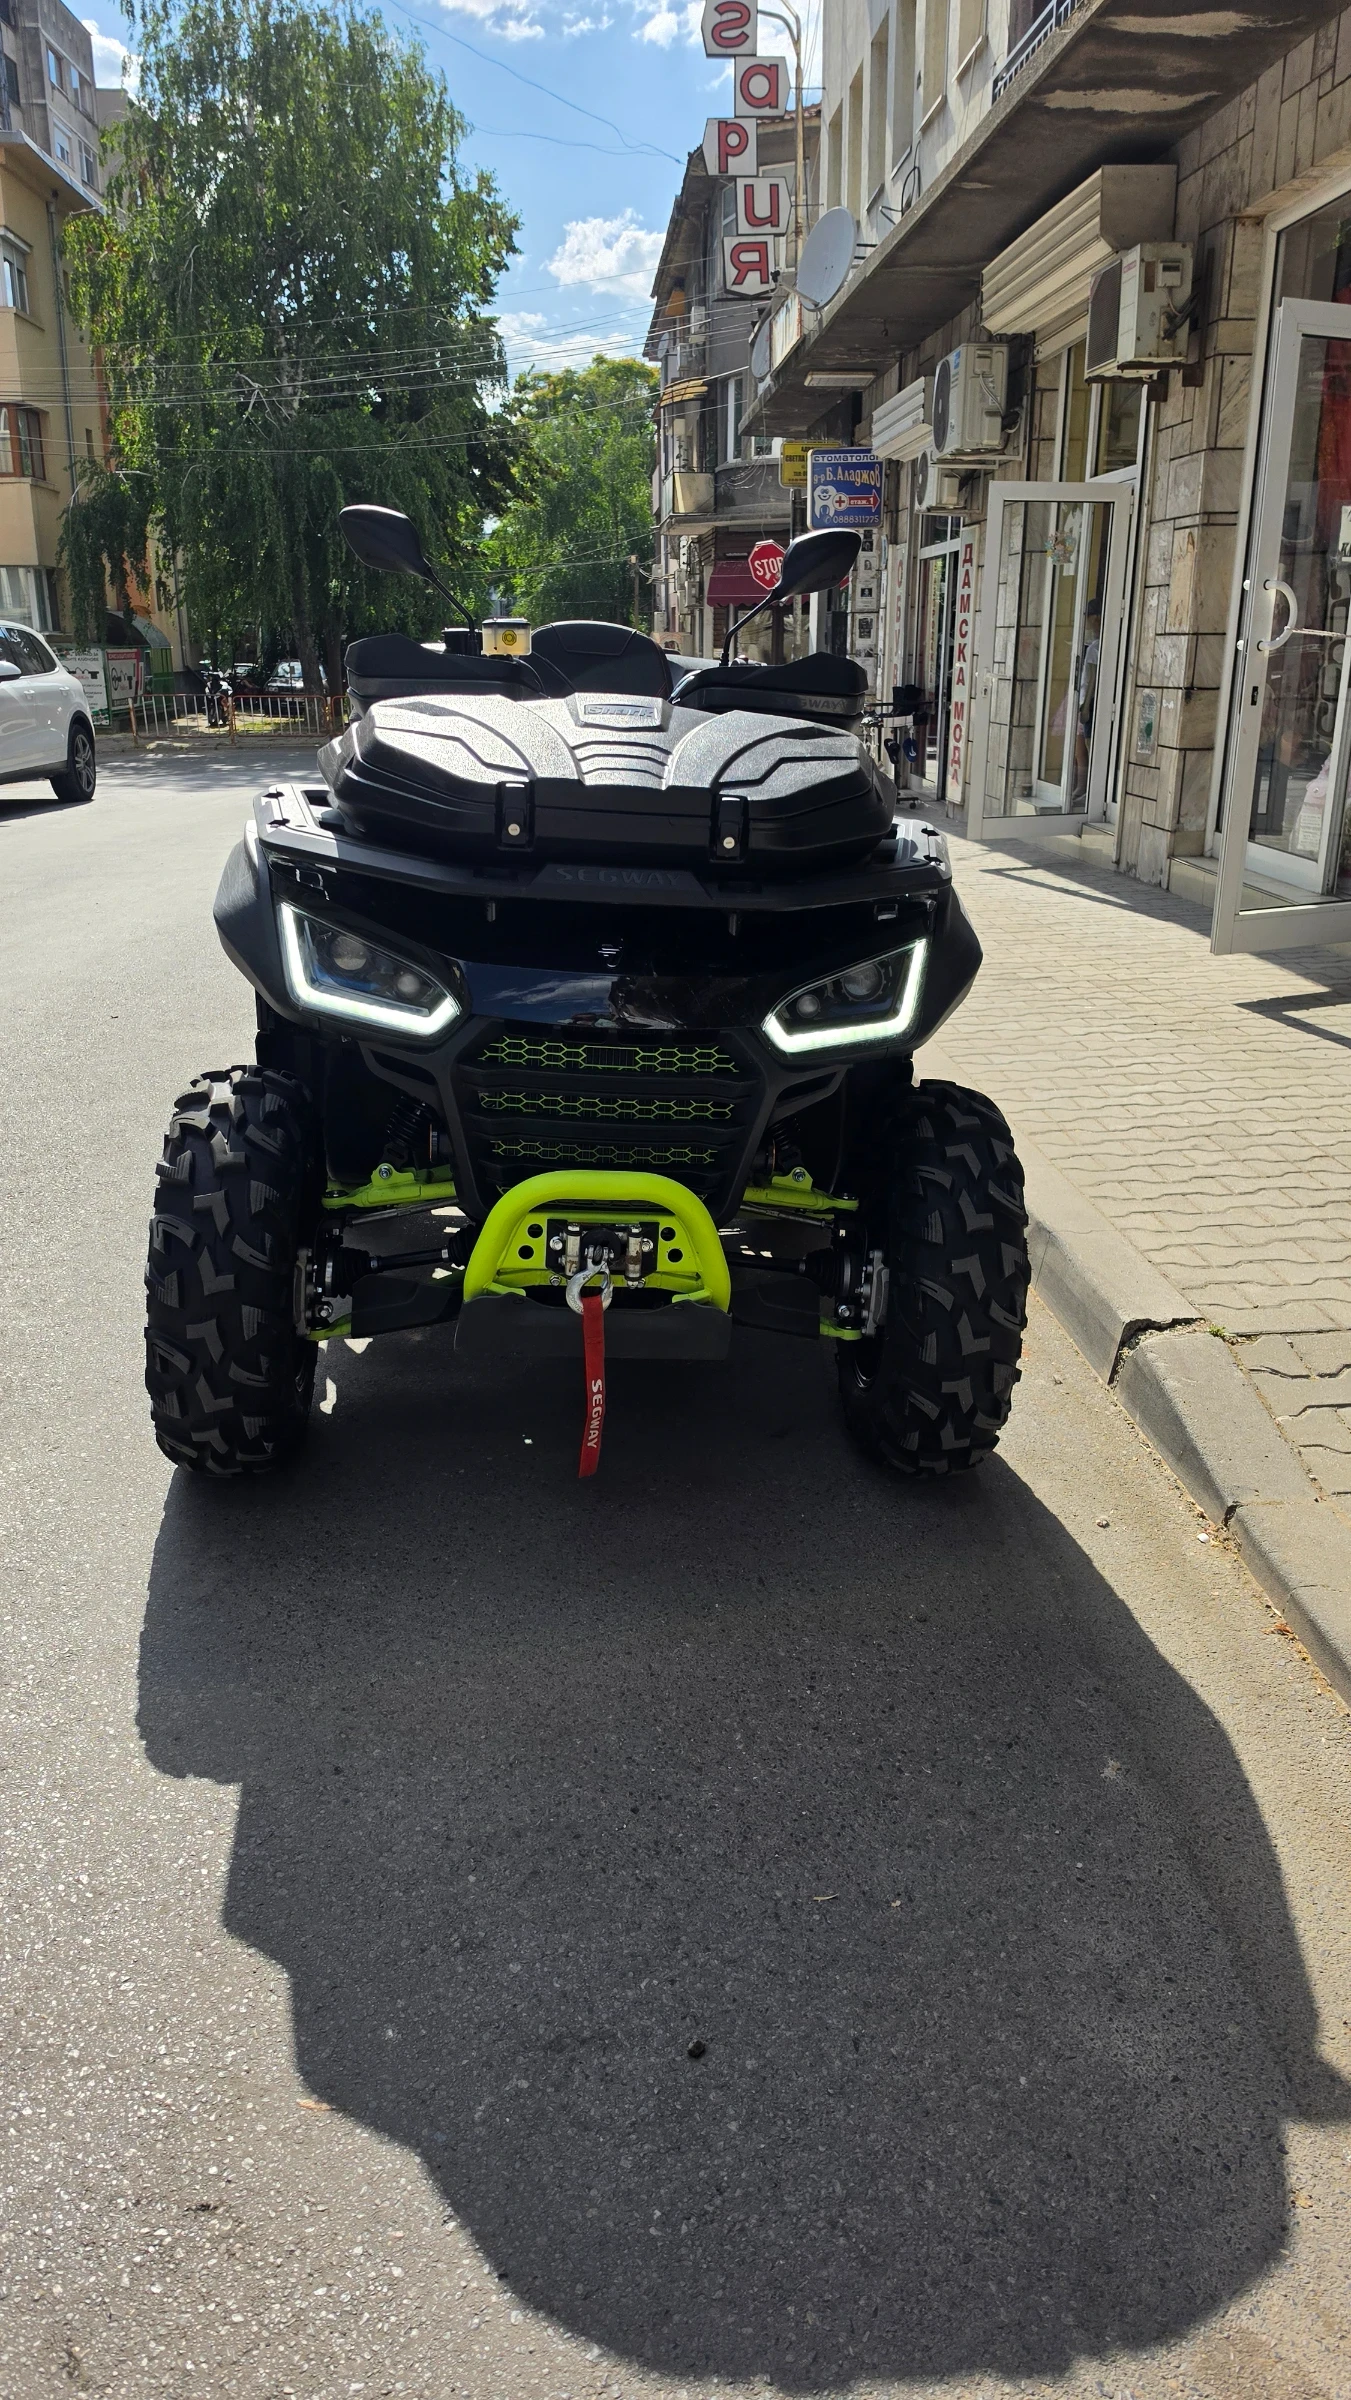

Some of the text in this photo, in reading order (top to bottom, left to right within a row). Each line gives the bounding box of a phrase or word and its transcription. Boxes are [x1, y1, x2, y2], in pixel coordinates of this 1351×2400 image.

[832, 515, 880, 524] 0888311775
[951, 543, 973, 787] ДАМСКА МОДА
[555, 867, 681, 887] SEGWAY
[586, 1379, 603, 1449] SEGWAY
